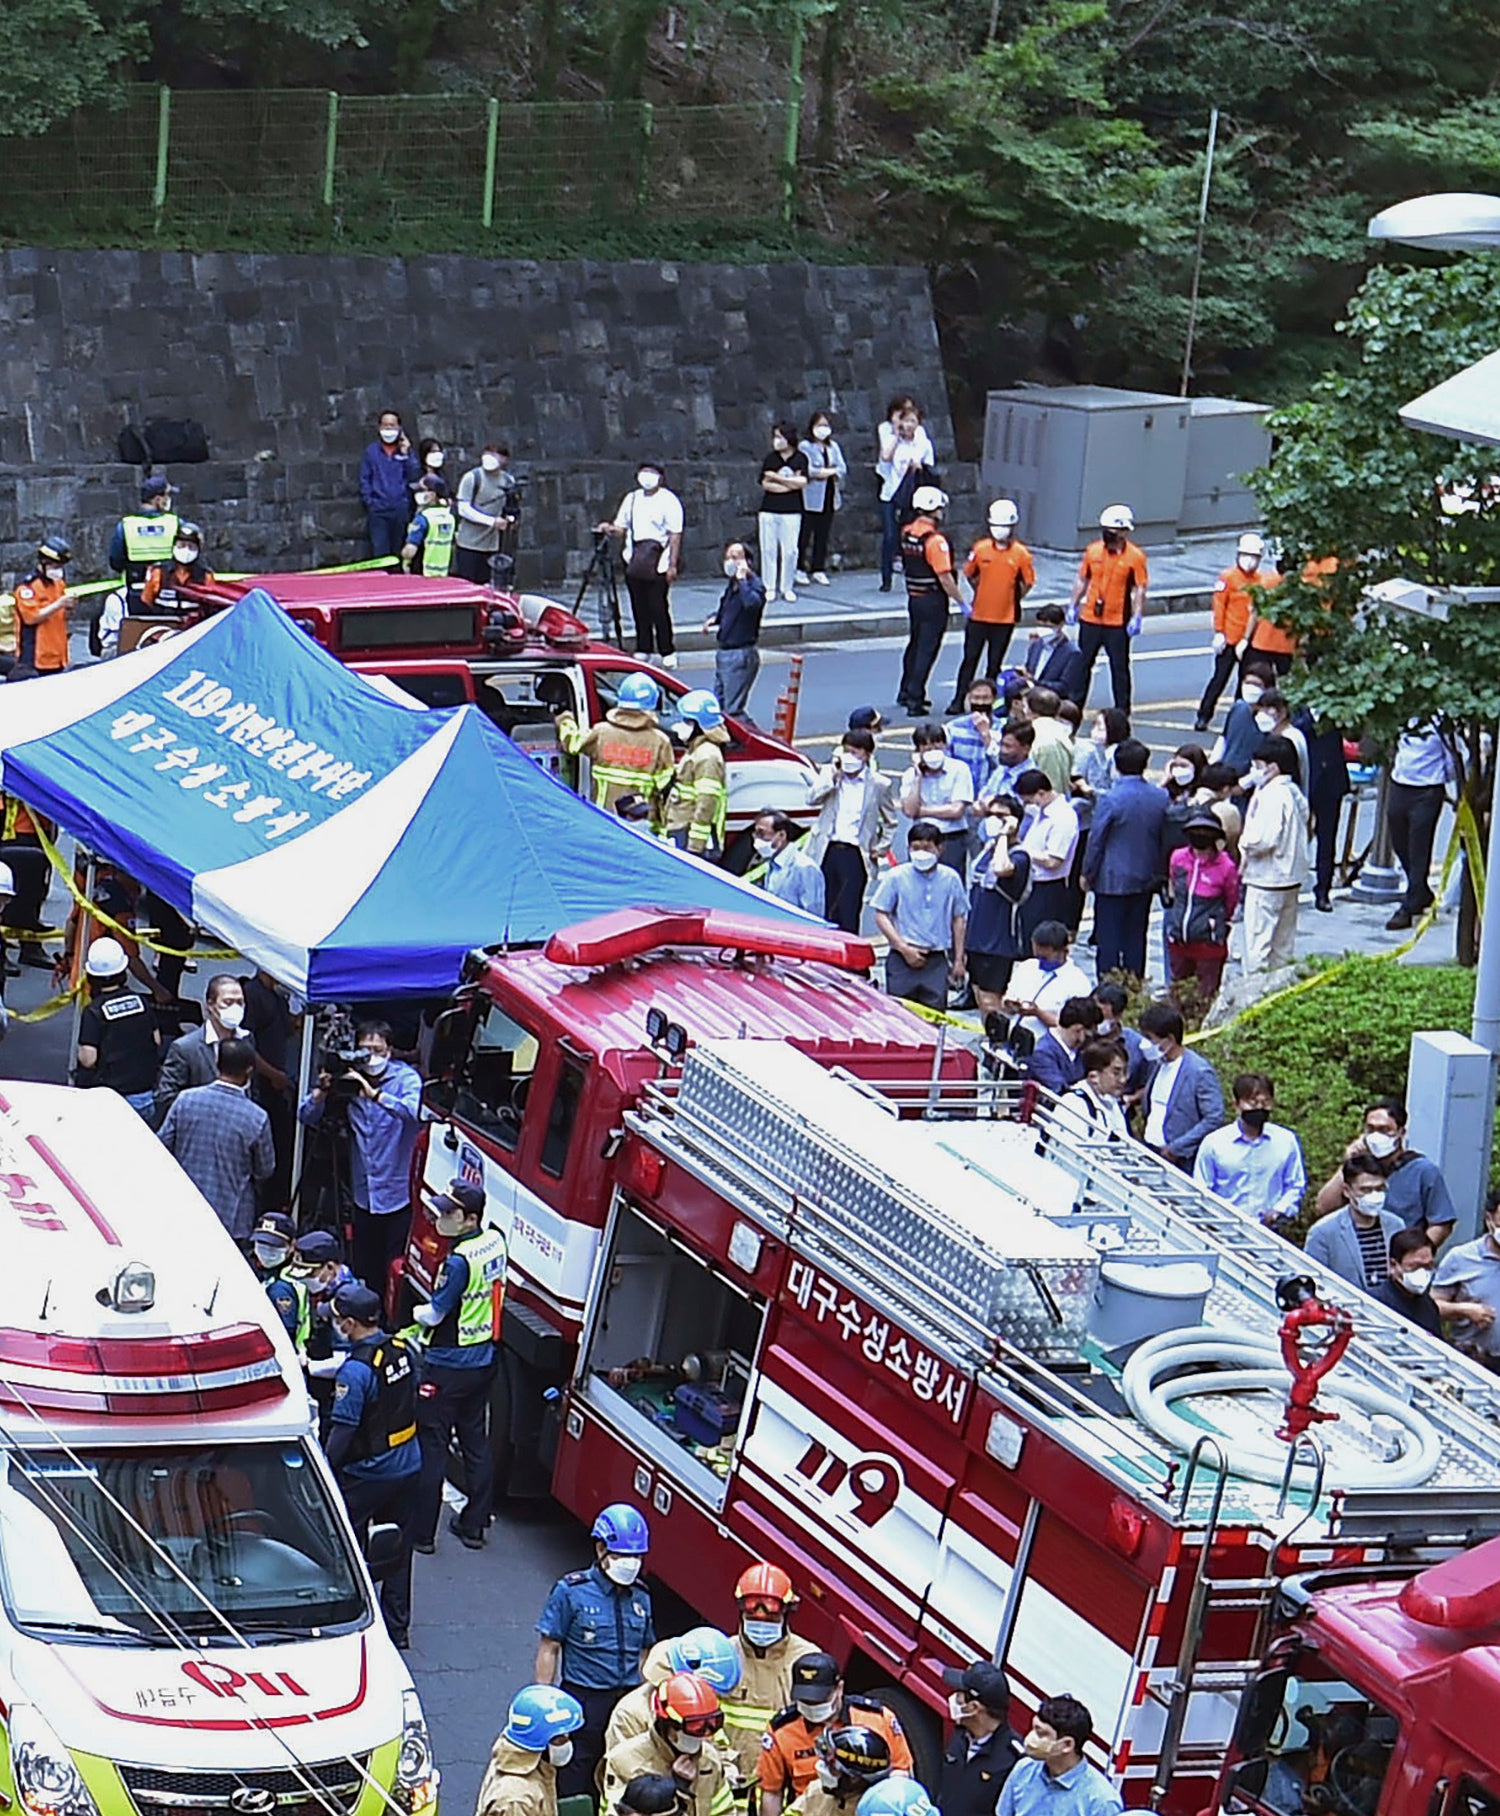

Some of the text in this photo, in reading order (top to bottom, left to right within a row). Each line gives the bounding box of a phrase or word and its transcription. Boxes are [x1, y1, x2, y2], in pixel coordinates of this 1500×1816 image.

[110, 709, 310, 839] 대구수성소방서
[786, 1259, 968, 1425] 대구수성소방서
[794, 1433, 901, 1529] 119
